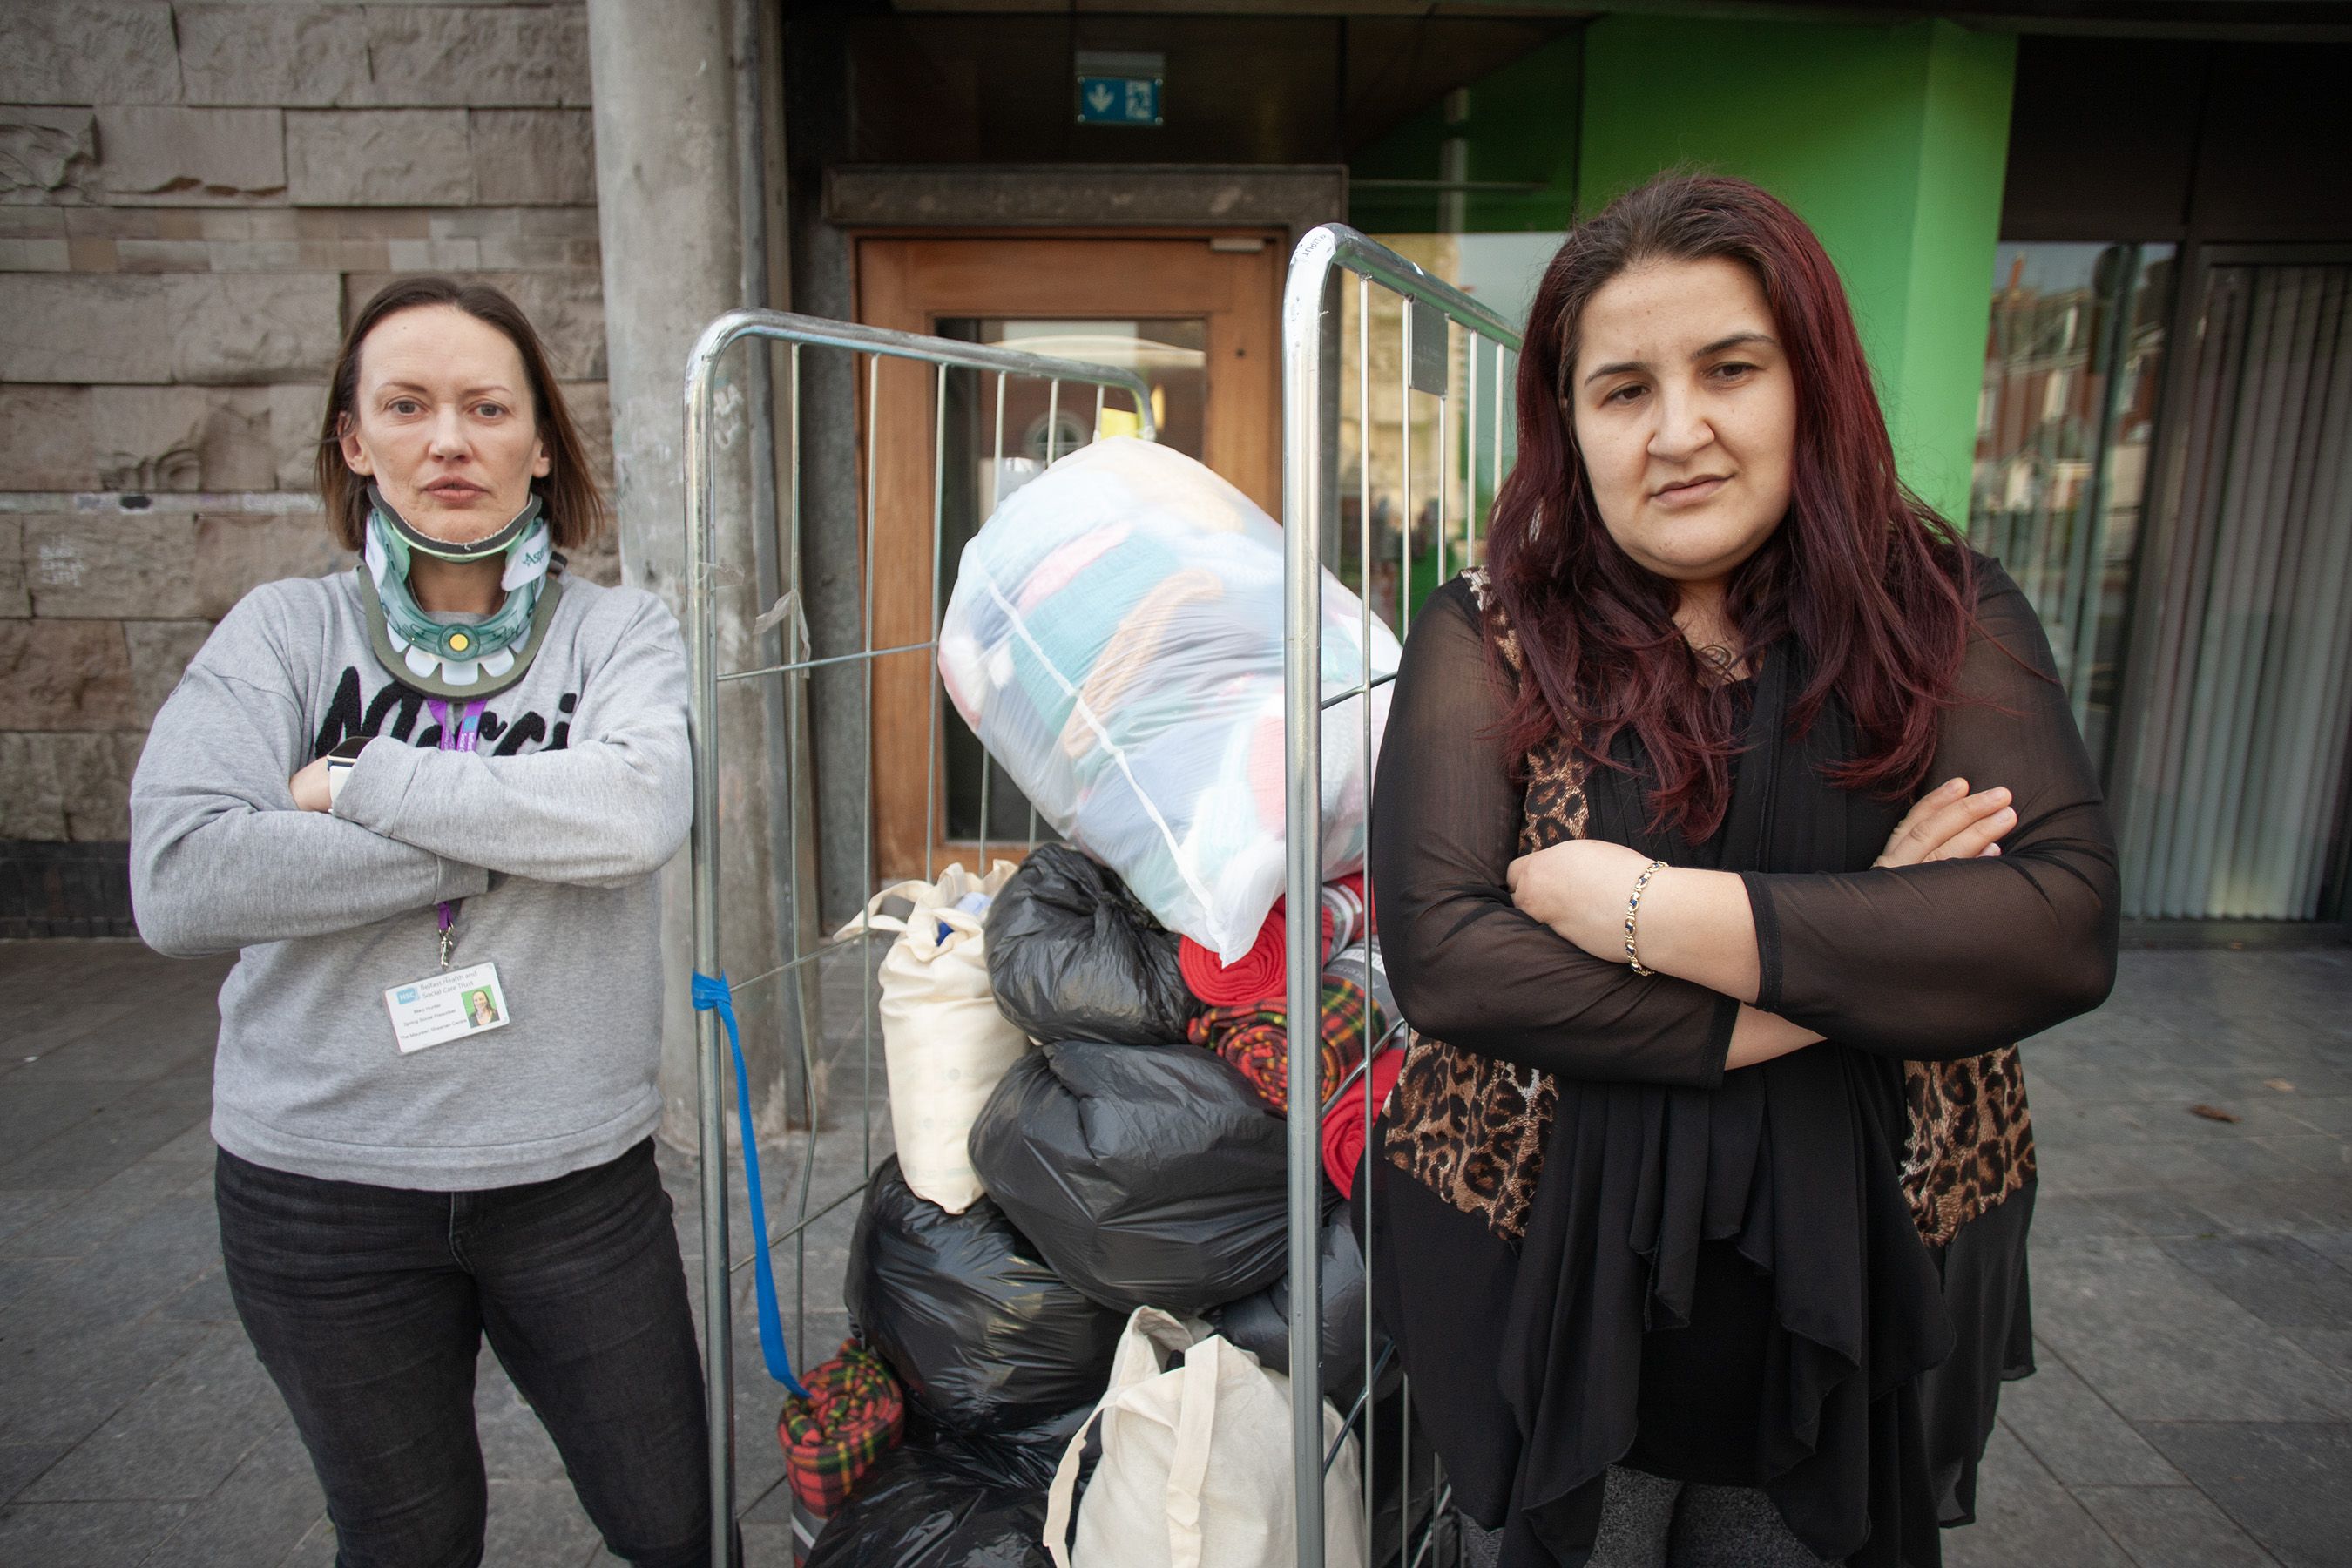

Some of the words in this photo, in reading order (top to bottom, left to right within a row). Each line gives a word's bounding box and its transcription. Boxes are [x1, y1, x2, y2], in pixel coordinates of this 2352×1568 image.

[420, 981, 442, 990] Belfast
[443, 974, 464, 984] Health
[400, 991, 415, 1000] HSC
[422, 989, 442, 999] Social
[443, 985, 457, 994] Care
